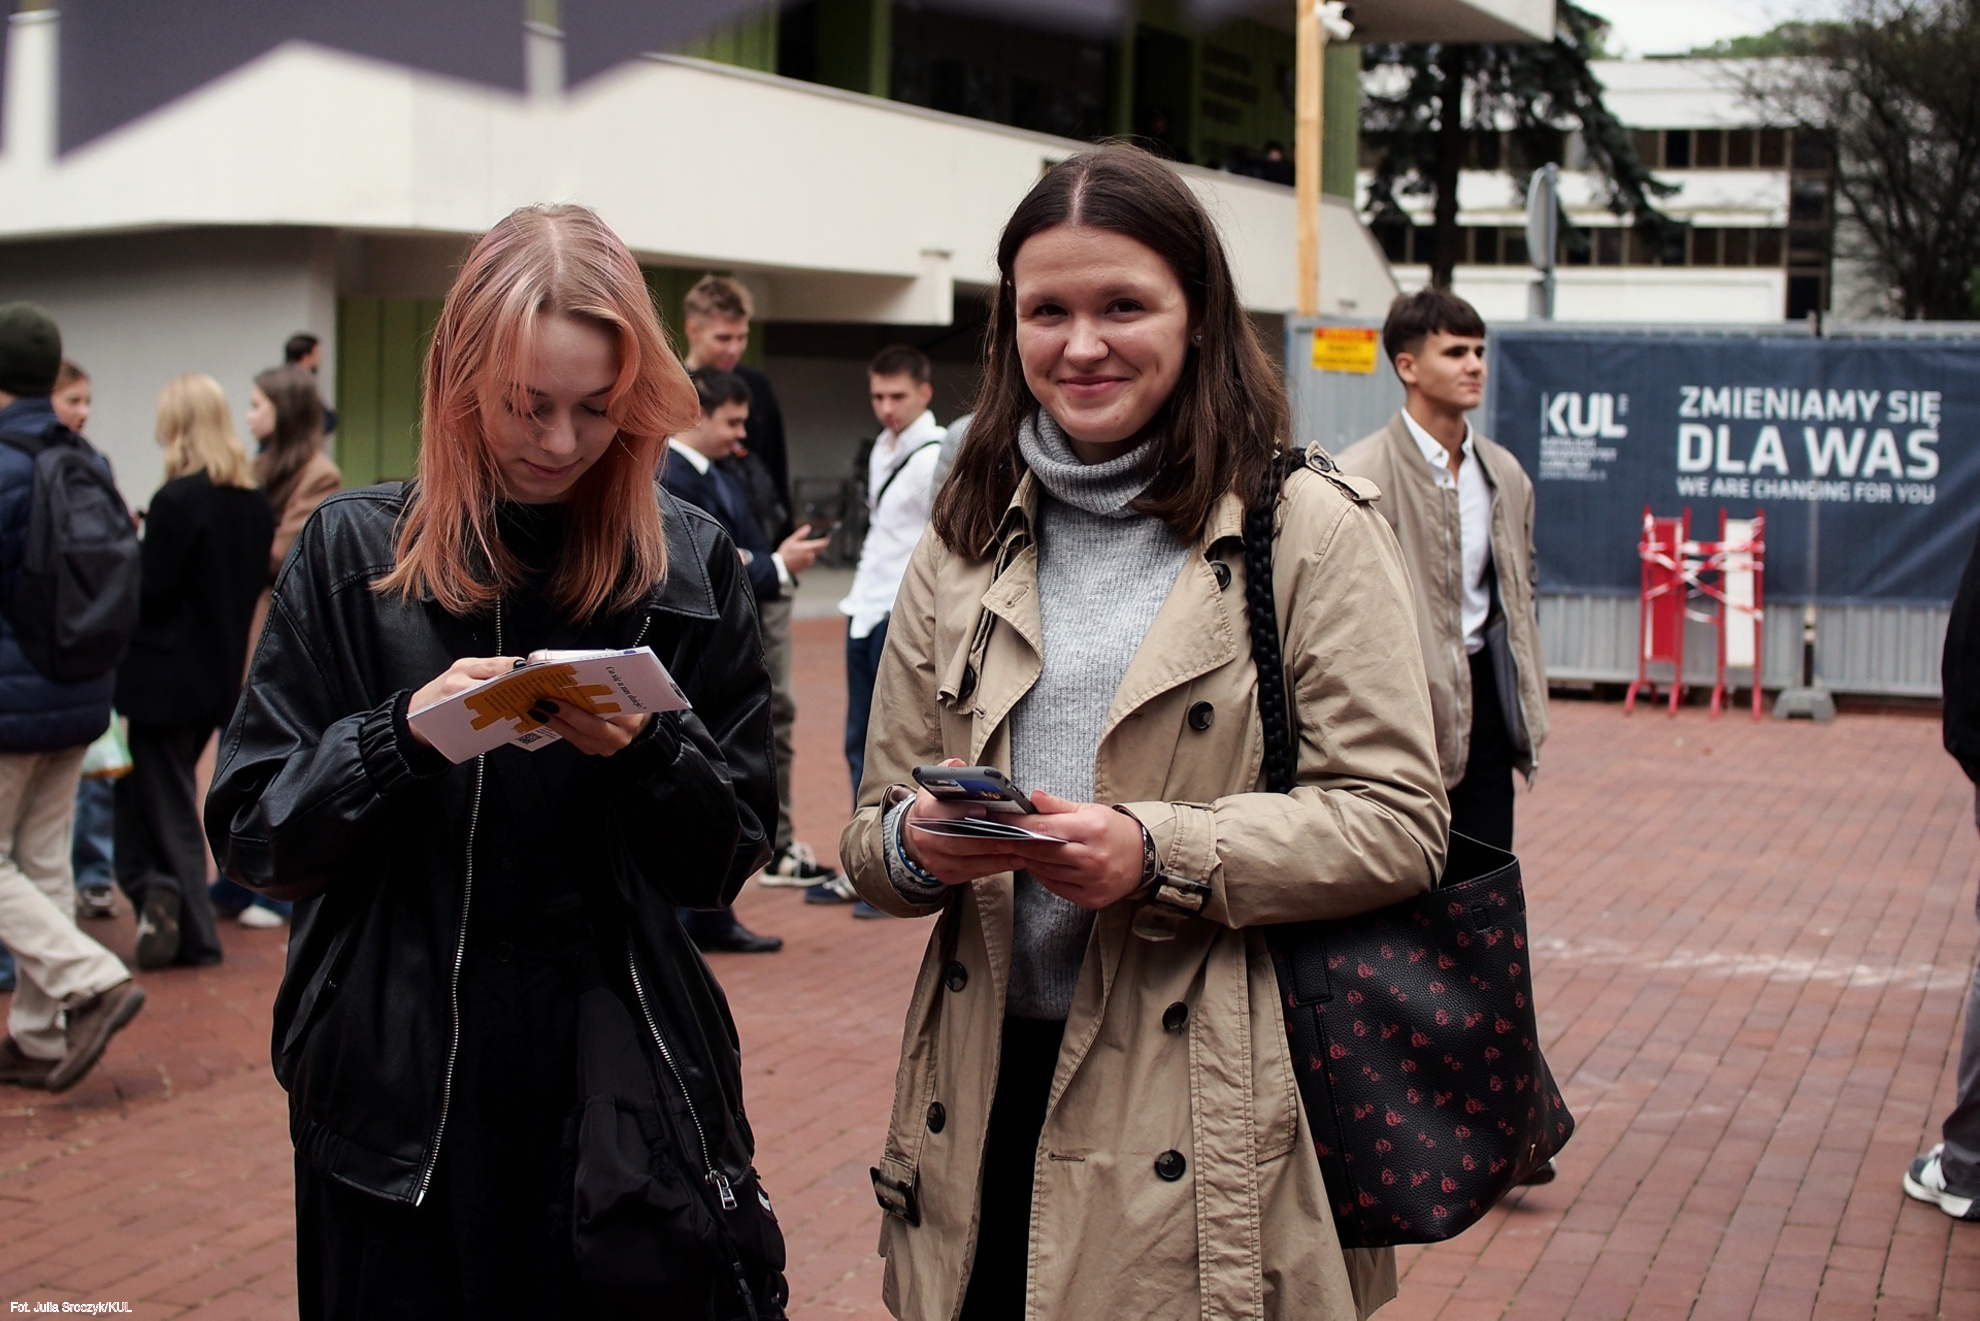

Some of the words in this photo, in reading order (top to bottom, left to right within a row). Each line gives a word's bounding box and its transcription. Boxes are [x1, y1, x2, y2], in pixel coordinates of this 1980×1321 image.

[1541, 391, 1628, 439] KUL
[1679, 385, 1881, 422] ZMIENIAMY
[1886, 390, 1942, 429] SIĘ
[1678, 422, 1789, 475] DLA
[1803, 426, 1940, 480] WAS
[1677, 476, 1709, 498] WE
[1711, 477, 1751, 499] ARE
[1752, 478, 1851, 502] CHANGING
[1853, 481, 1893, 503] FOR
[1896, 483, 1936, 505] YOU
